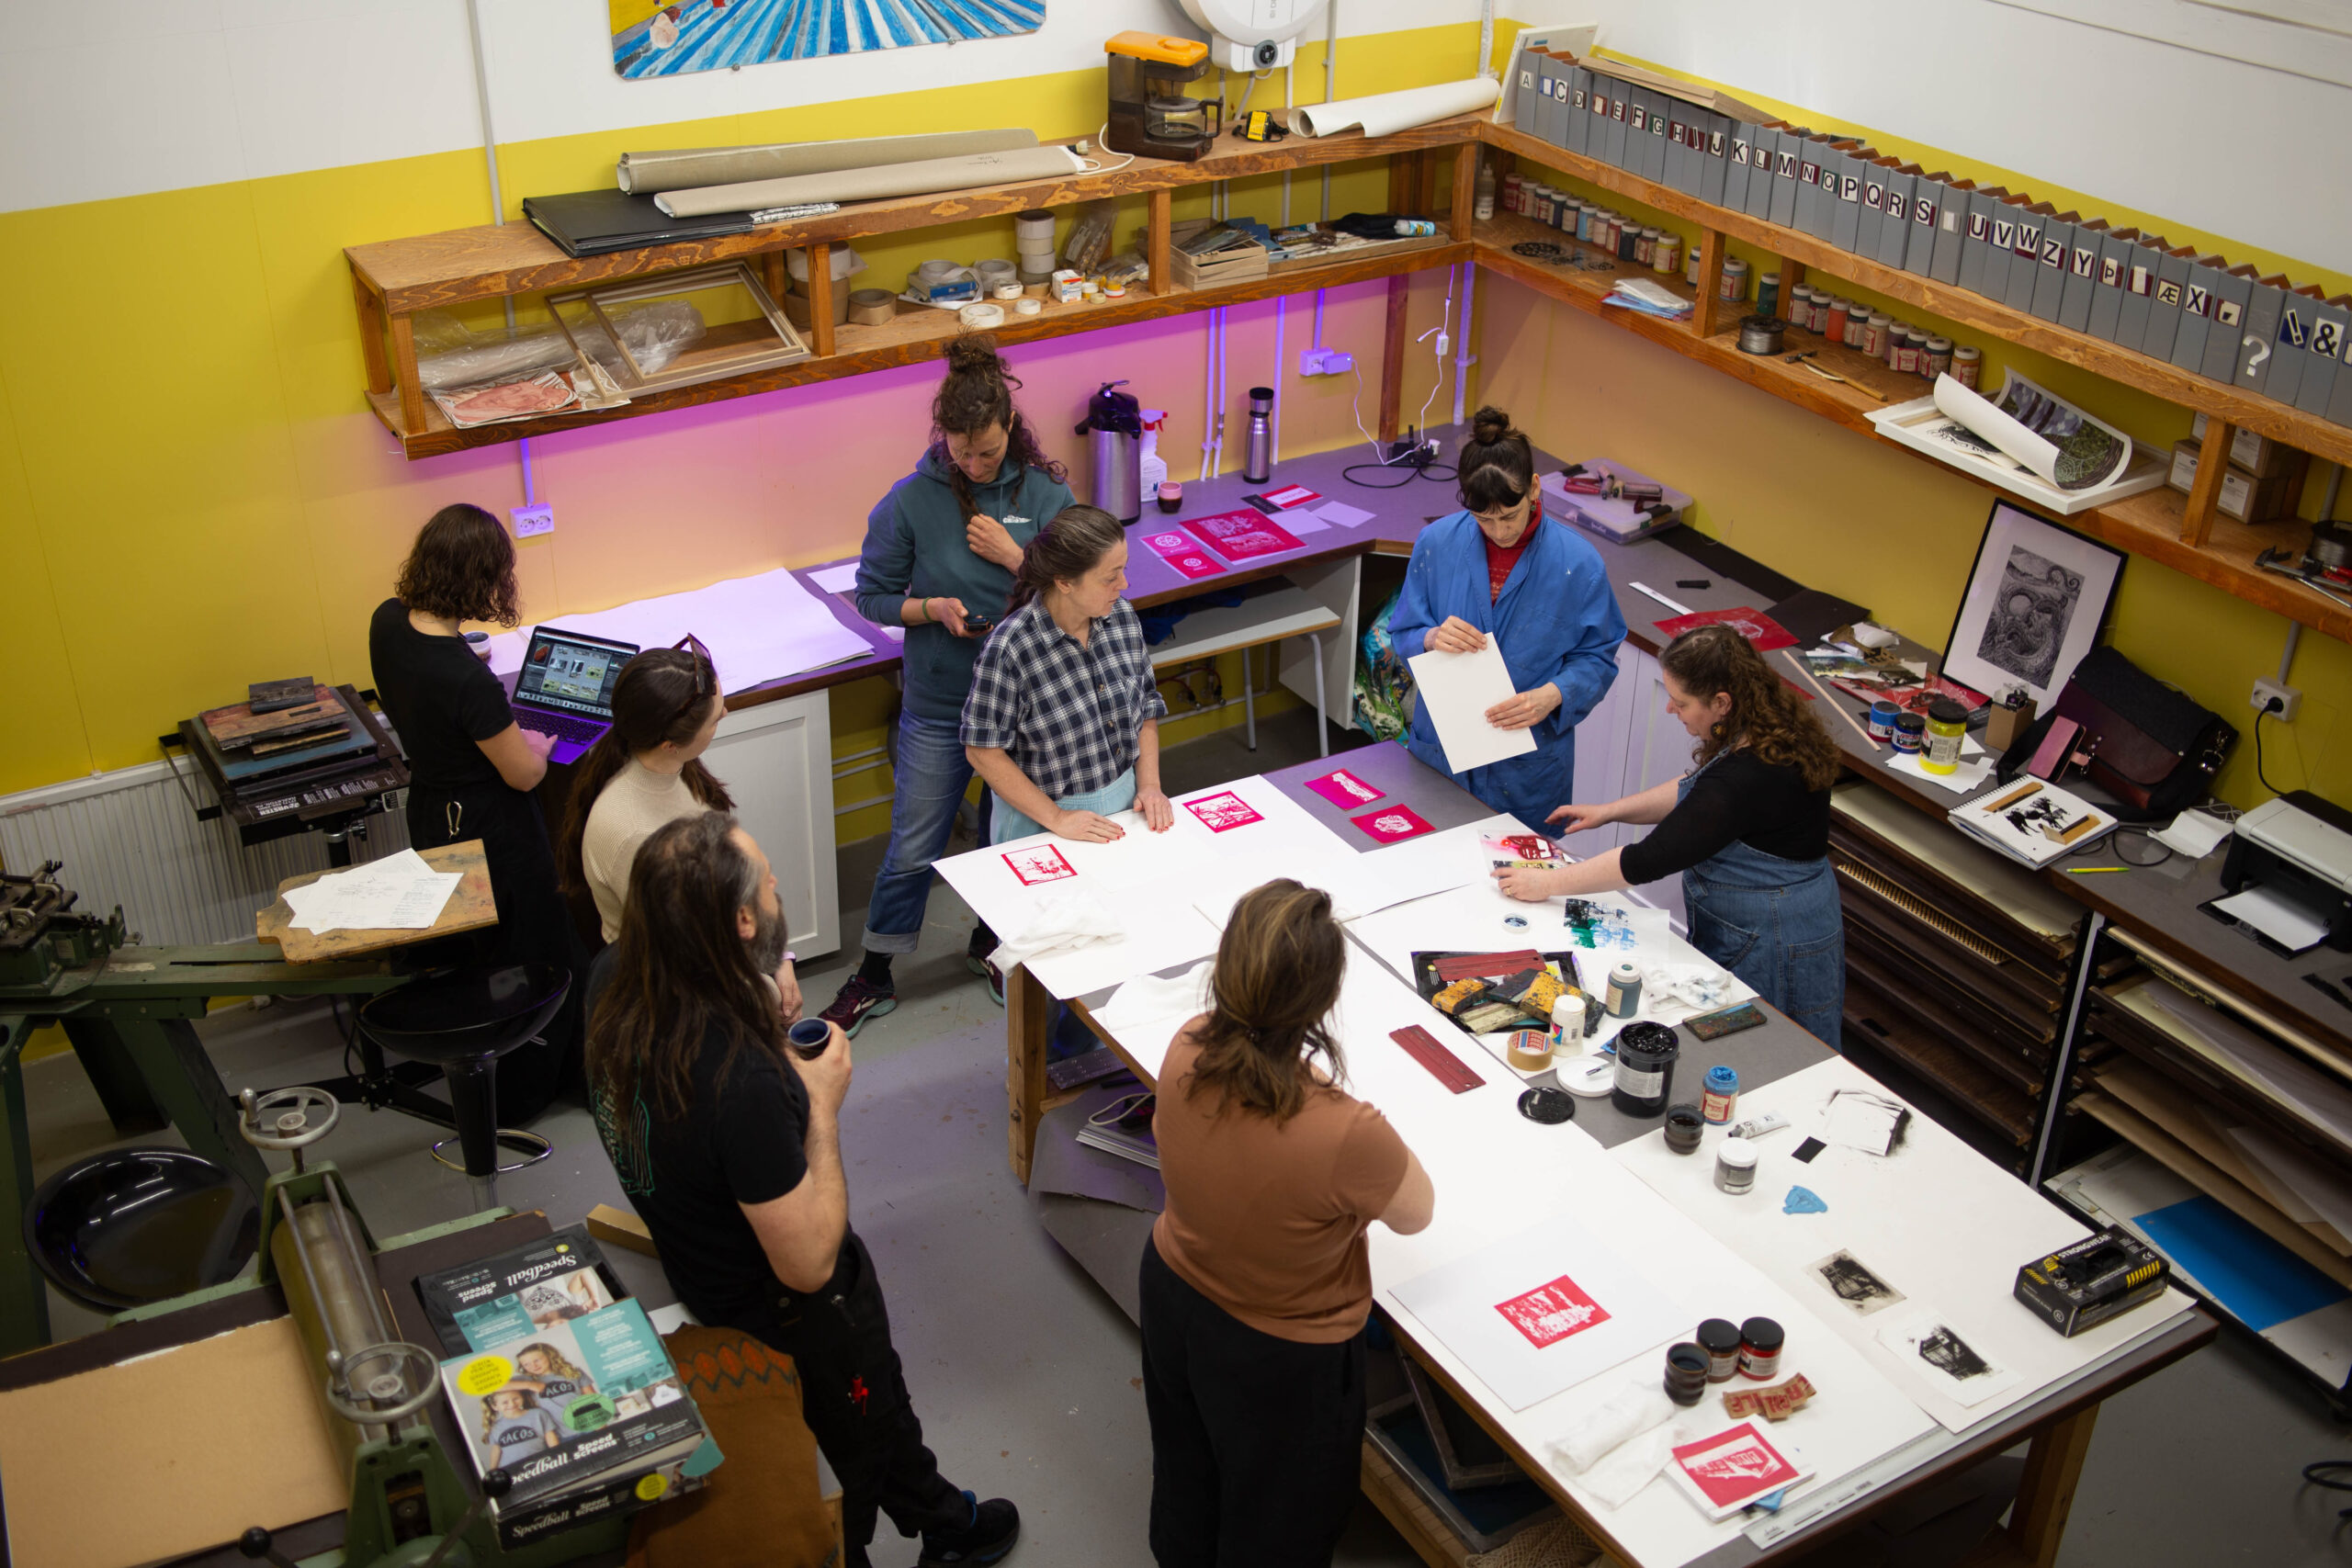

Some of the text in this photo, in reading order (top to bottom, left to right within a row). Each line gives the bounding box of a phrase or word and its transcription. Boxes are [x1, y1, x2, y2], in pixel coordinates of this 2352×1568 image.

[1522, 73, 1530, 87] A
[1555, 81, 1566, 100] C
[1576, 93, 1583, 106] D
[1613, 104, 1622, 118] E
[1632, 106, 1643, 124] F
[1654, 119, 1662, 133] G
[1674, 125, 1682, 140] H
[1713, 135, 1724, 152] J
[1732, 141, 1746, 162] K
[1756, 152, 1763, 166] L
[1778, 153, 1793, 175] M
[1803, 165, 1814, 180] N
[1824, 175, 1834, 188] O
[1844, 177, 1857, 197] P
[1866, 184, 1881, 206] Q
[1888, 192, 1902, 215] R
[1917, 200, 1930, 221] S
[1971, 214, 1985, 237] U
[1997, 222, 2012, 244] V
[2019, 224, 2041, 249] W
[2042, 240, 2059, 265] Z
[2077, 251, 2091, 274] Y
[2159, 286, 2178, 304] Æ
[2187, 287, 2204, 312] X
[2312, 323, 2338, 357] &
[2242, 334, 2271, 378] ?
[506, 1255, 577, 1287] Speedball
[547, 1382, 572, 1396] ACOS
[501, 1429, 535, 1444] TACOS
[578, 1433, 613, 1452] Speed
[511, 1452, 569, 1484] eedball
[513, 1510, 570, 1538] Speedball
